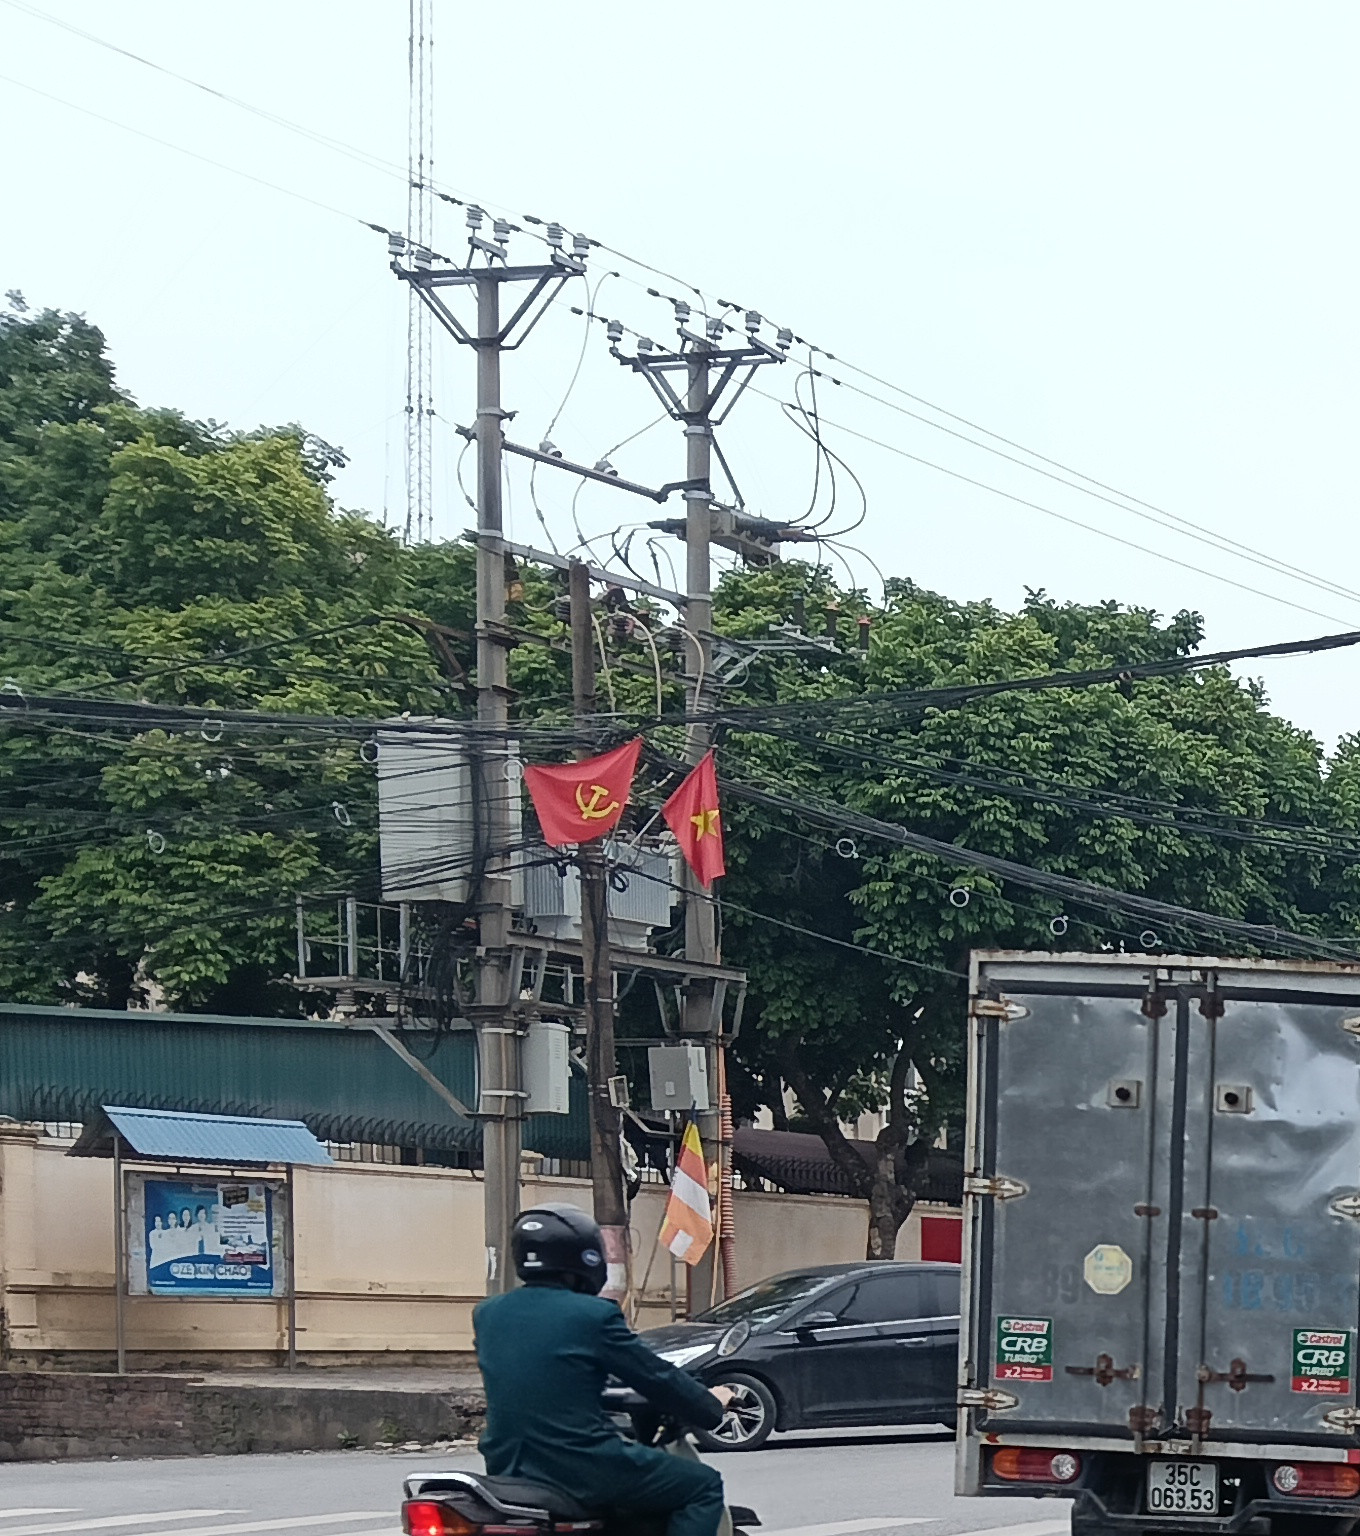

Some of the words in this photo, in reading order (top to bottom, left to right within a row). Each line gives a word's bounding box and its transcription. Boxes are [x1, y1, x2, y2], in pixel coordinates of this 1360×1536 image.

[1013, 1322, 1045, 1332] Castrol
[1001, 1337, 1048, 1353] CRB
[1309, 1334, 1343, 1345] Castrol
[1297, 1349, 1346, 1366] CRB
[1165, 1464, 1201, 1486] 35C
[1152, 1487, 1214, 1511] 063.53
